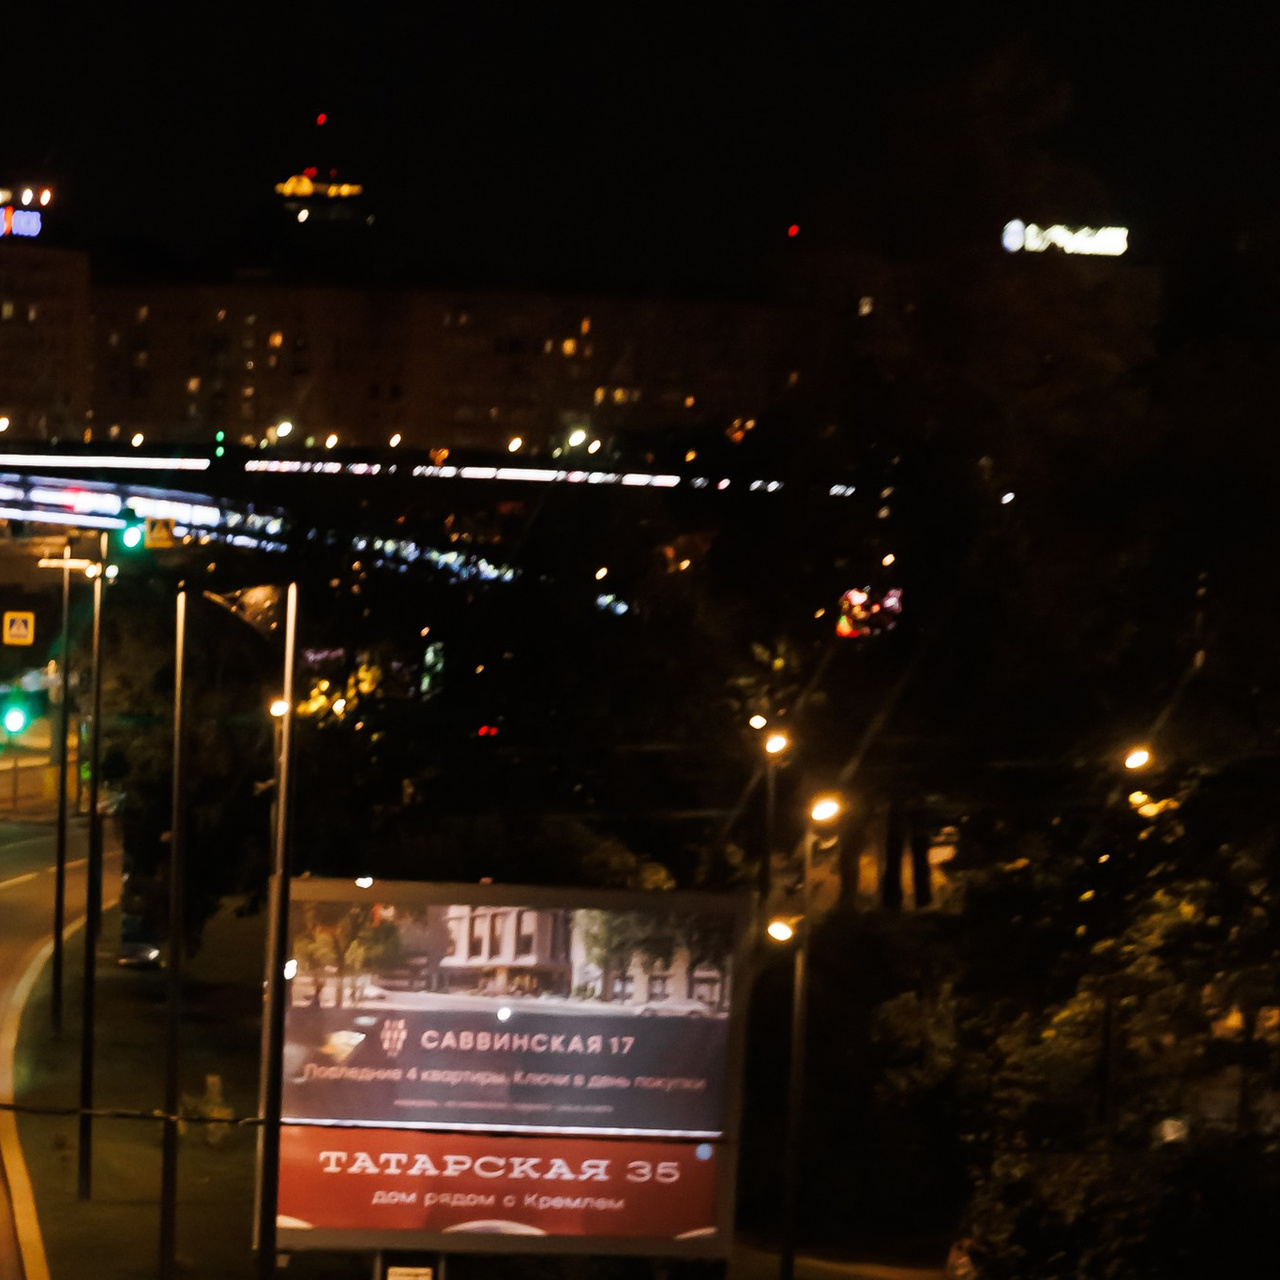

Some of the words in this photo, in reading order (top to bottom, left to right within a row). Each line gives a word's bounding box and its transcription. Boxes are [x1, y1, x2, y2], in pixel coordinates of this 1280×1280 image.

[420, 1029, 603, 1054] САВВИНСКАЯ
[609, 1036, 636, 1055] 17
[320, 1151, 611, 1181] ТАТАРСКАЯ
[626, 1161, 680, 1183] 35
[372, 1190, 417, 1205] дом
[424, 1192, 495, 1208] рядом
